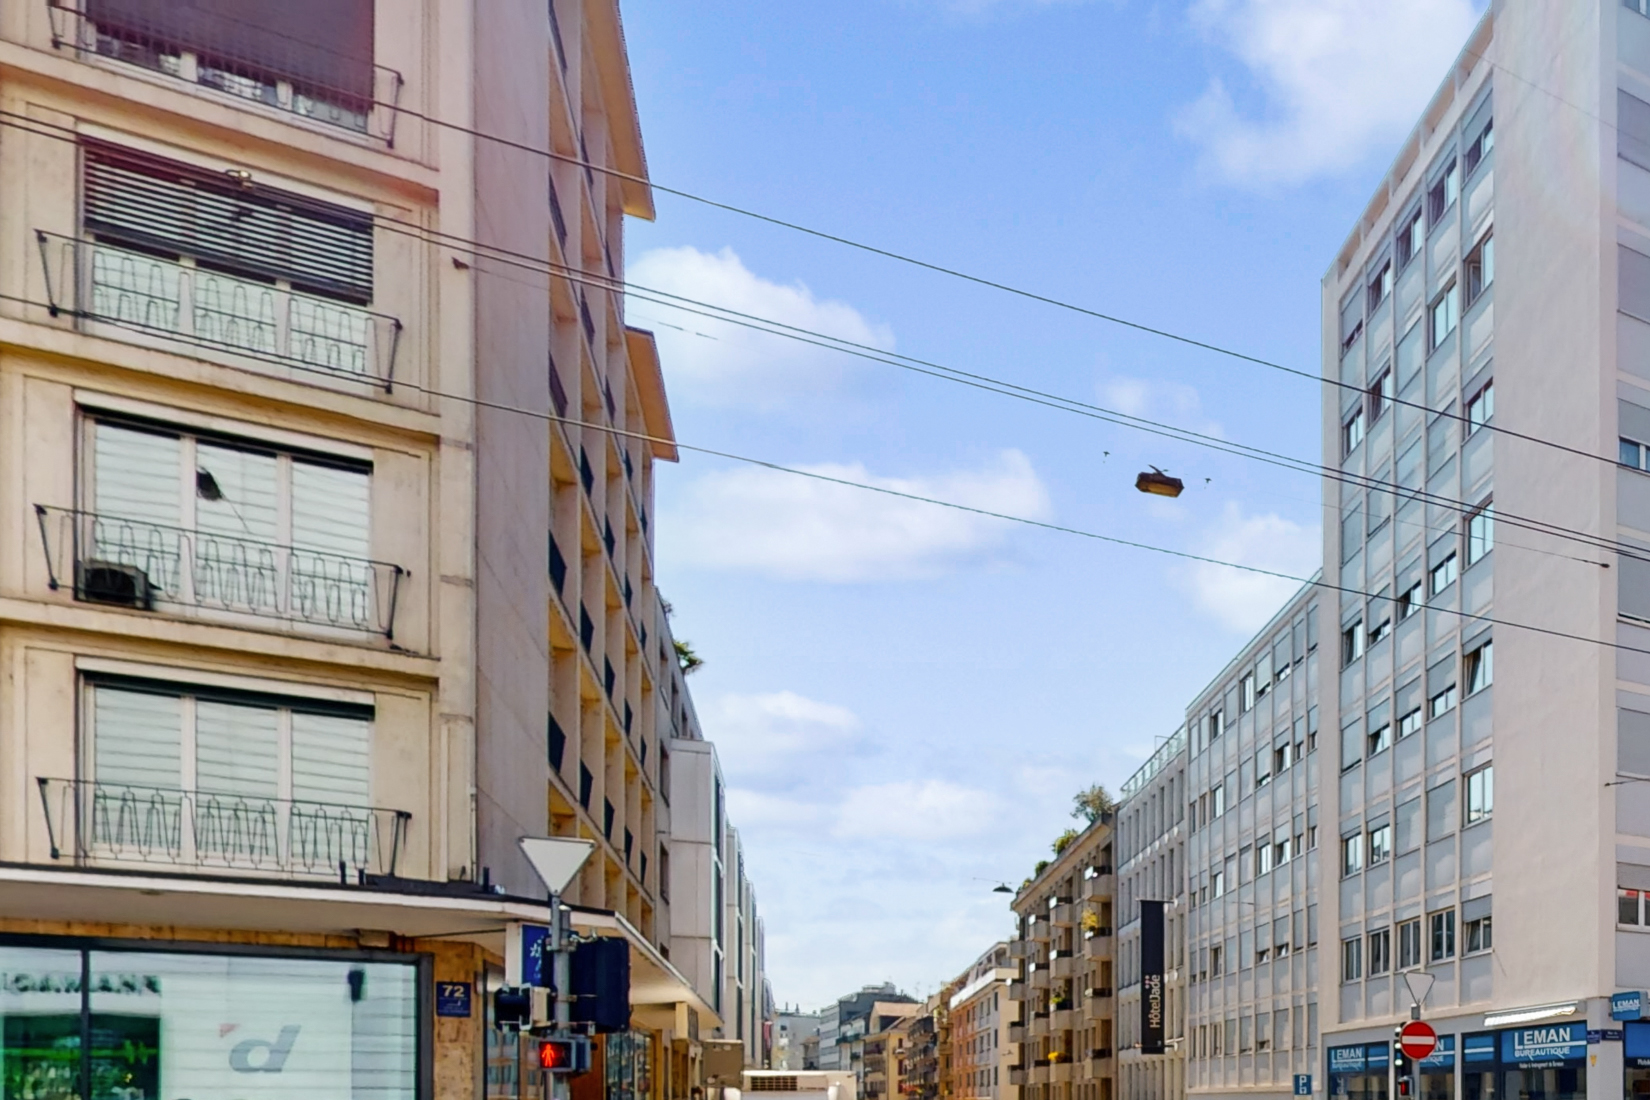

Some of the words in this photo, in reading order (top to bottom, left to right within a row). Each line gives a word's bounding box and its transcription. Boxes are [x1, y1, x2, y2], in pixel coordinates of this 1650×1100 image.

[442, 985, 465, 997] 72
[1613, 998, 1640, 1009] LEMAN
[1514, 1027, 1571, 1050] LEMAN
[1332, 1048, 1363, 1062] LEMAN
[1514, 1046, 1571, 1060] BUREAUTIQUE
[1299, 1076, 1307, 1085] P
